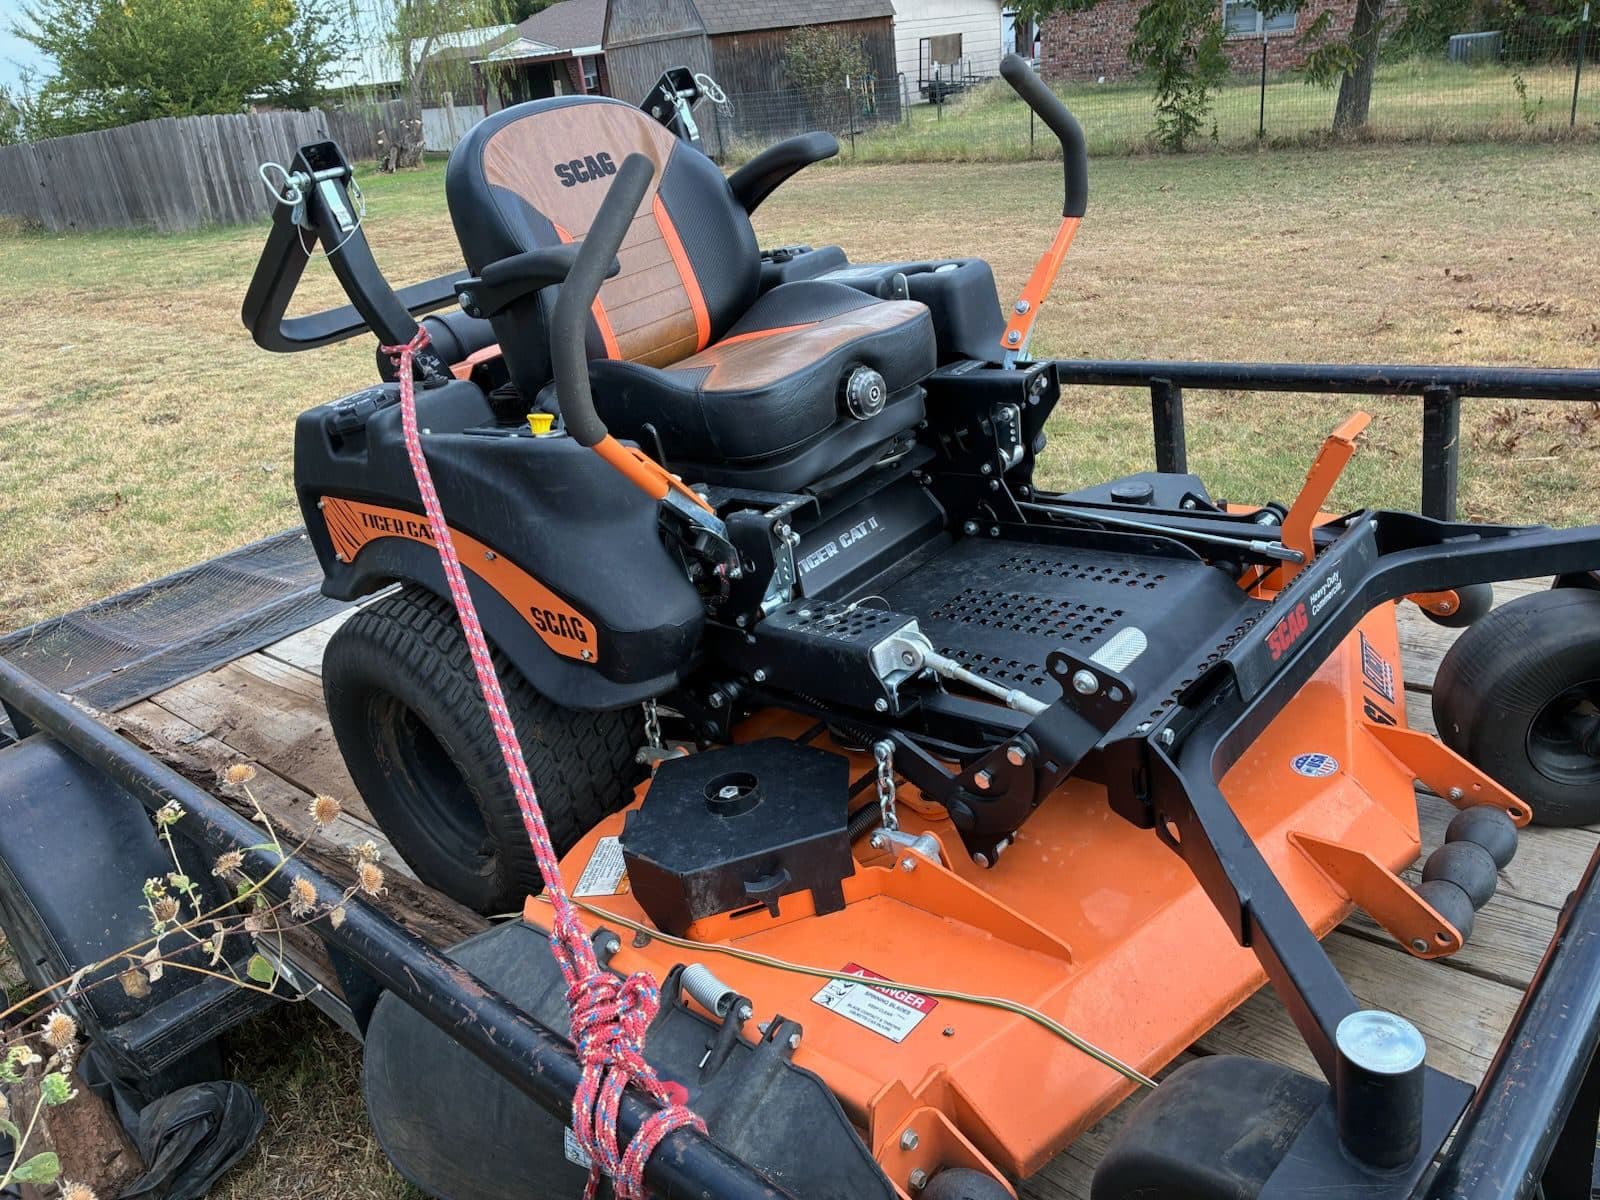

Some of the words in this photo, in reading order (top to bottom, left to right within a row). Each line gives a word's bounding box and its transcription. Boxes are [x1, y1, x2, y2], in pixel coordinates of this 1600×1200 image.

[554, 152, 616, 187] SCAG
[359, 511, 404, 536] TIGER
[839, 521, 868, 549] CAT
[529, 606, 589, 643] SCAG
[1267, 602, 1309, 661] SCAG
